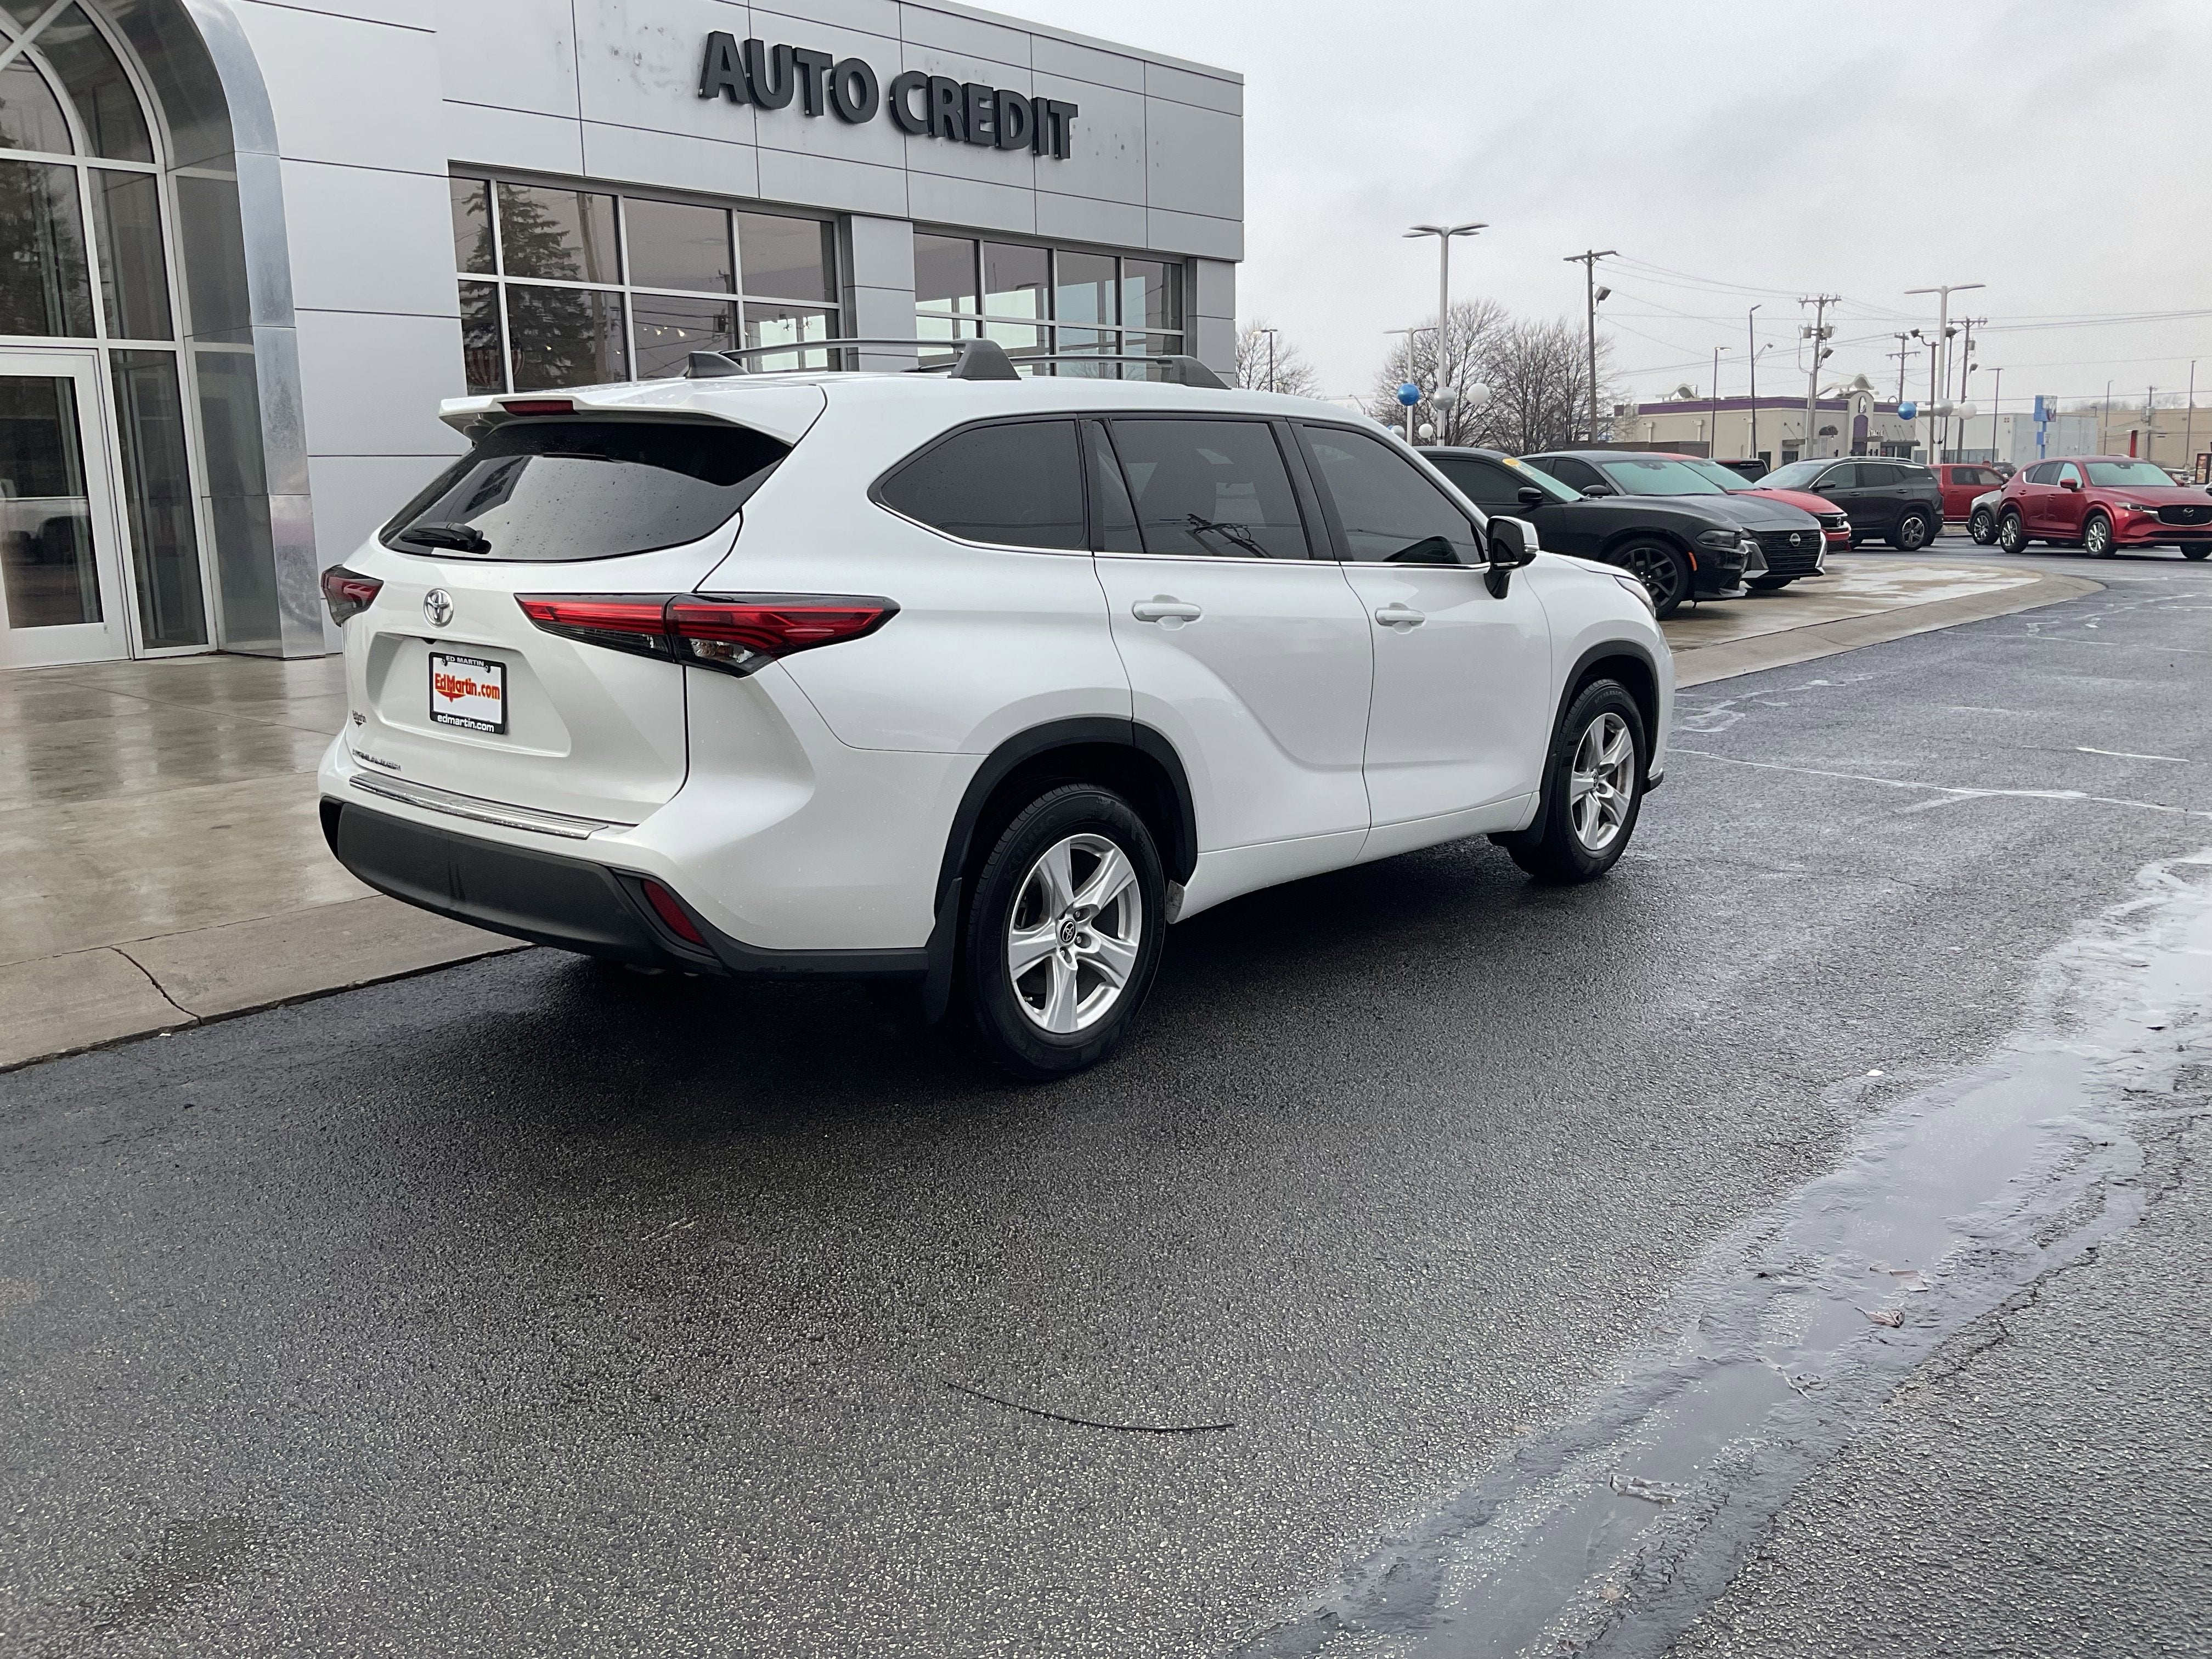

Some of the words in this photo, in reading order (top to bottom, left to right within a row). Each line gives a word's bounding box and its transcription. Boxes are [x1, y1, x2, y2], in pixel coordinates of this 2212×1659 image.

[698, 31, 879, 123] AUTO
[889, 71, 1078, 159] CREDIT
[457, 657, 484, 667] MARTIN
[435, 673, 500, 700] EdMartin.com
[437, 714, 494, 732] edmartin.com
